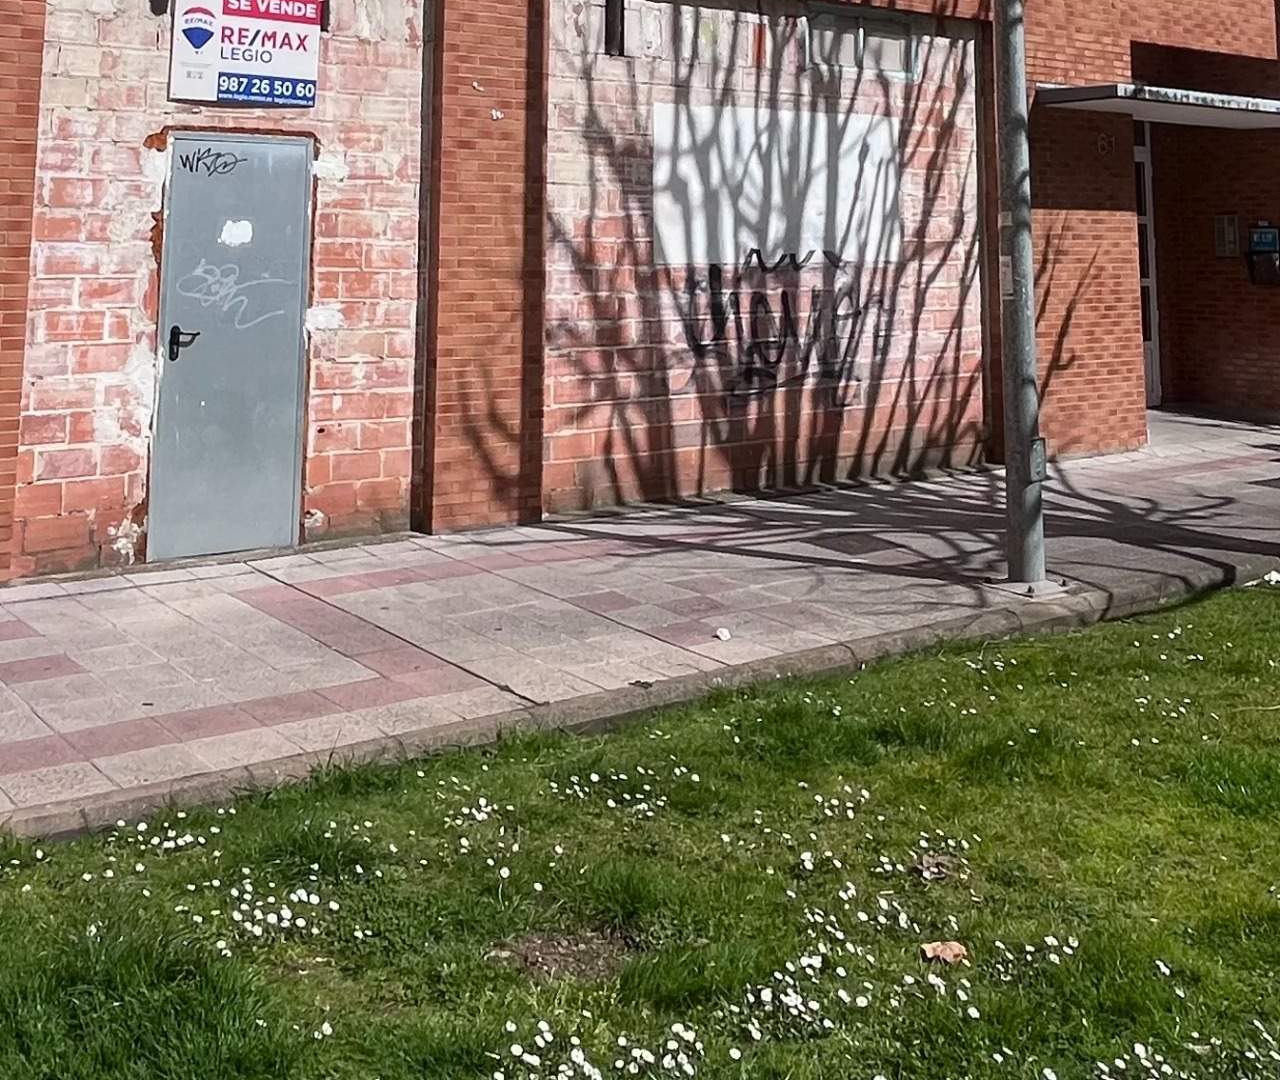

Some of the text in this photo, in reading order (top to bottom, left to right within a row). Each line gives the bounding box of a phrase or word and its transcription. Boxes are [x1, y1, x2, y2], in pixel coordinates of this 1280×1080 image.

[221, 26, 309, 52] RE/MAX
[220, 46, 272, 63] LEGIO
[219, 76, 315, 97] 987 26 50 60
[1097, 132, 1116, 155] 61
